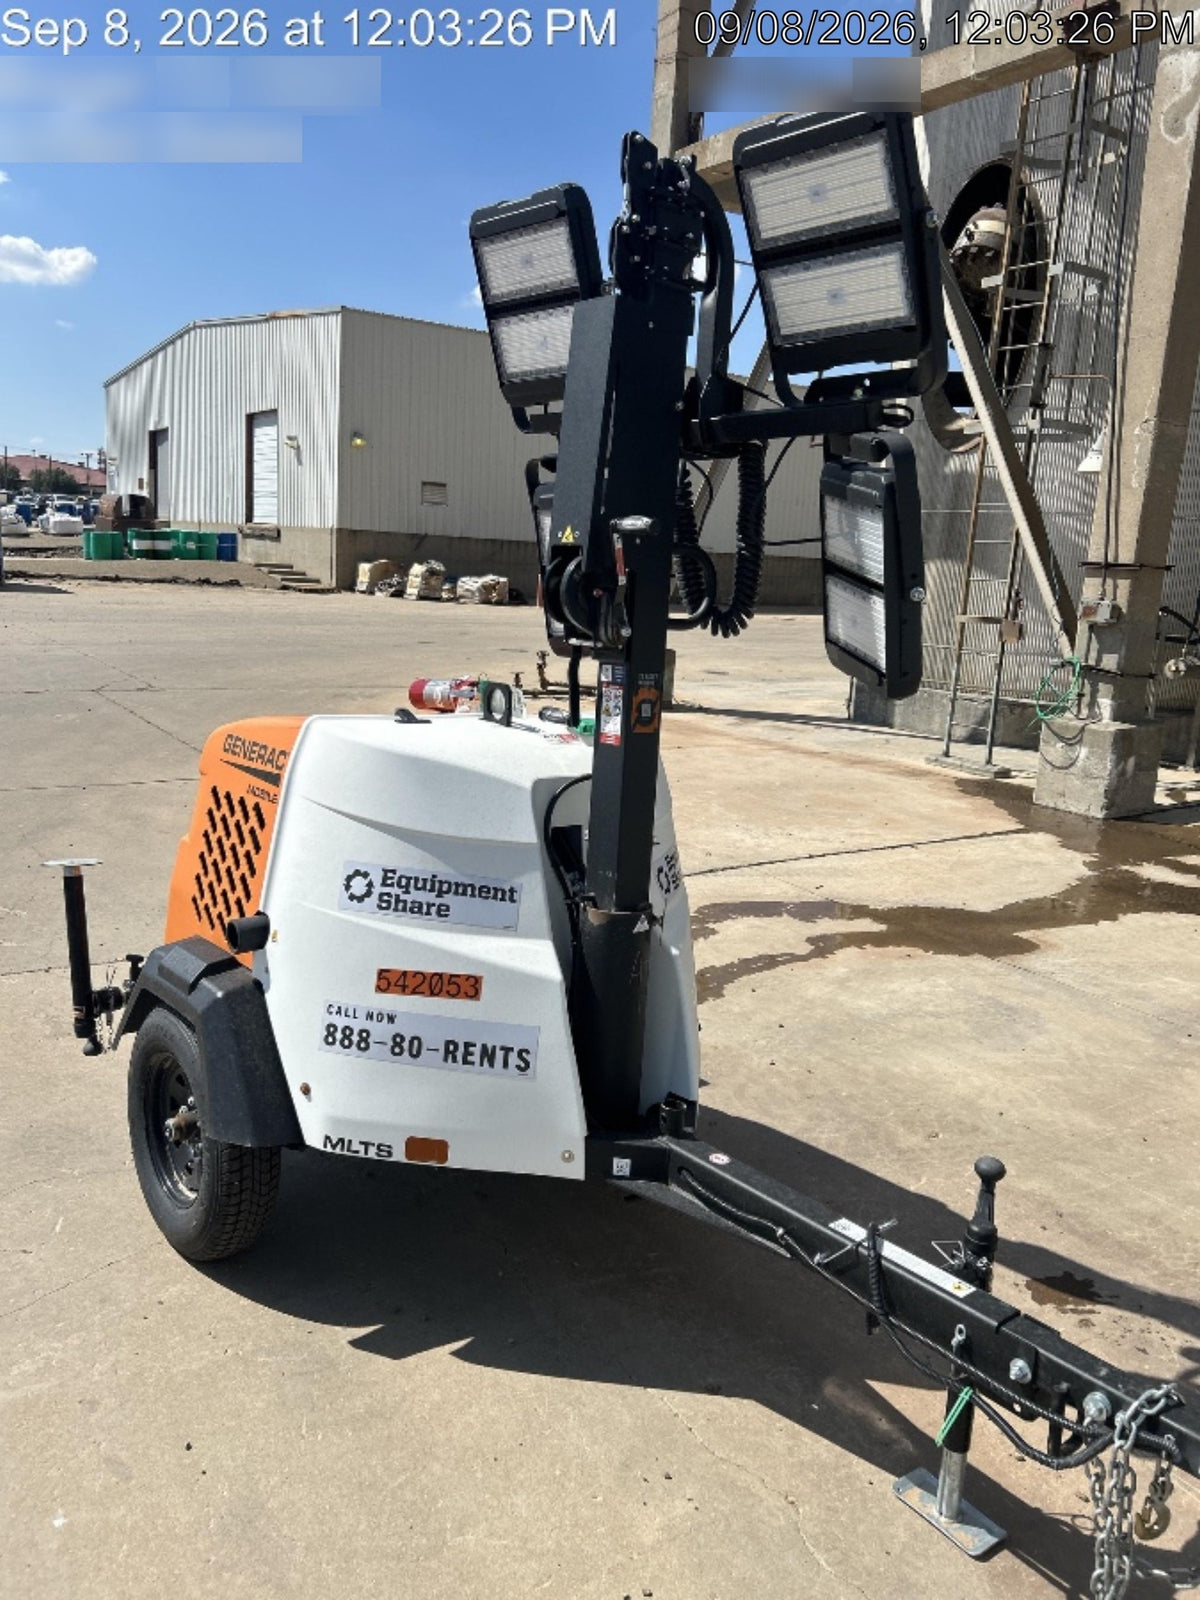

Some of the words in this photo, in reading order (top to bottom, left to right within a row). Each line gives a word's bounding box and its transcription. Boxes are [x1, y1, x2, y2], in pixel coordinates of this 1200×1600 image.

[223, 733, 287, 771] GENERAC
[380, 868, 517, 903] Equipment
[376, 892, 450, 918] Share
[376, 968, 480, 998] 542053
[326, 1004, 359, 1020] CALL
[365, 1010, 397, 1024] NOW
[323, 1022, 531, 1073] 888-80-RENTS
